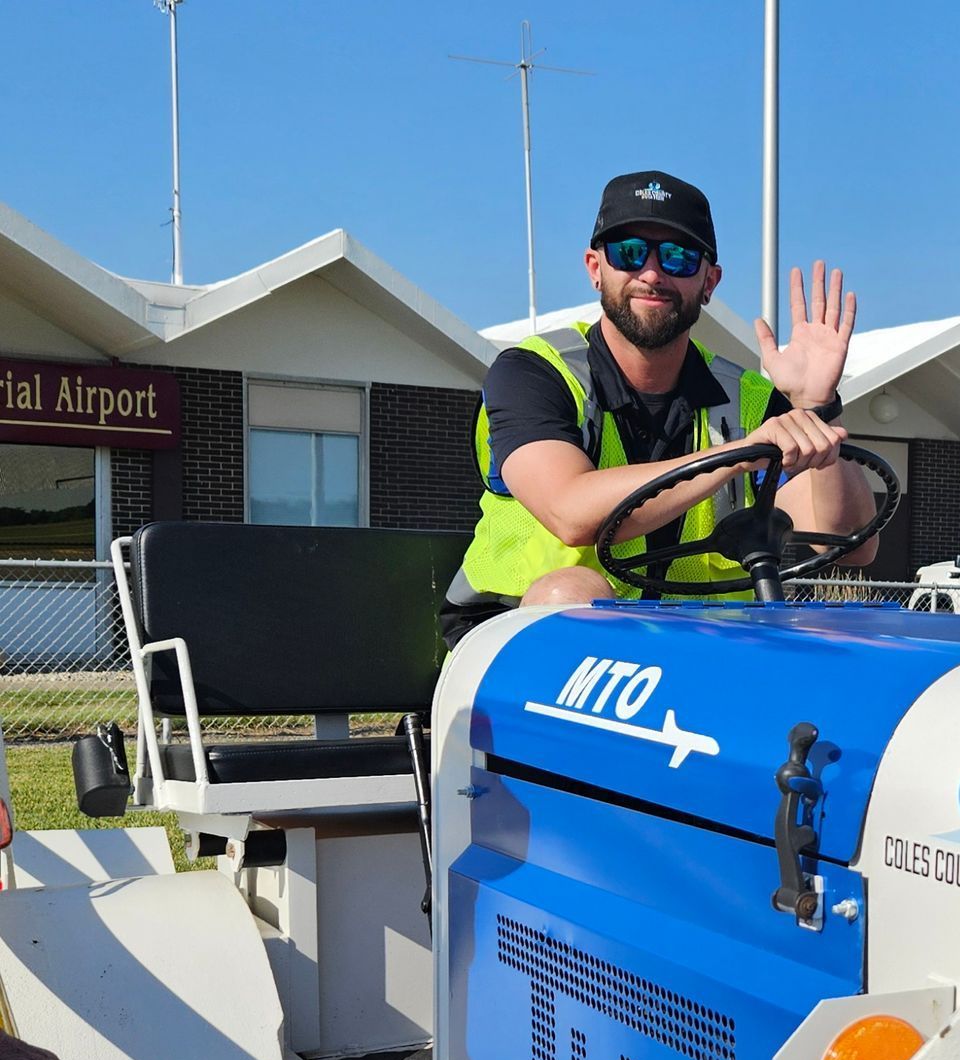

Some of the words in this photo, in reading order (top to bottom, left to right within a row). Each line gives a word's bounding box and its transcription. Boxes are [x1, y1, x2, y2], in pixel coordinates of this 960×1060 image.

[55, 375, 157, 424] Airport
[555, 656, 663, 721] MTO
[884, 835, 930, 878] COLES
